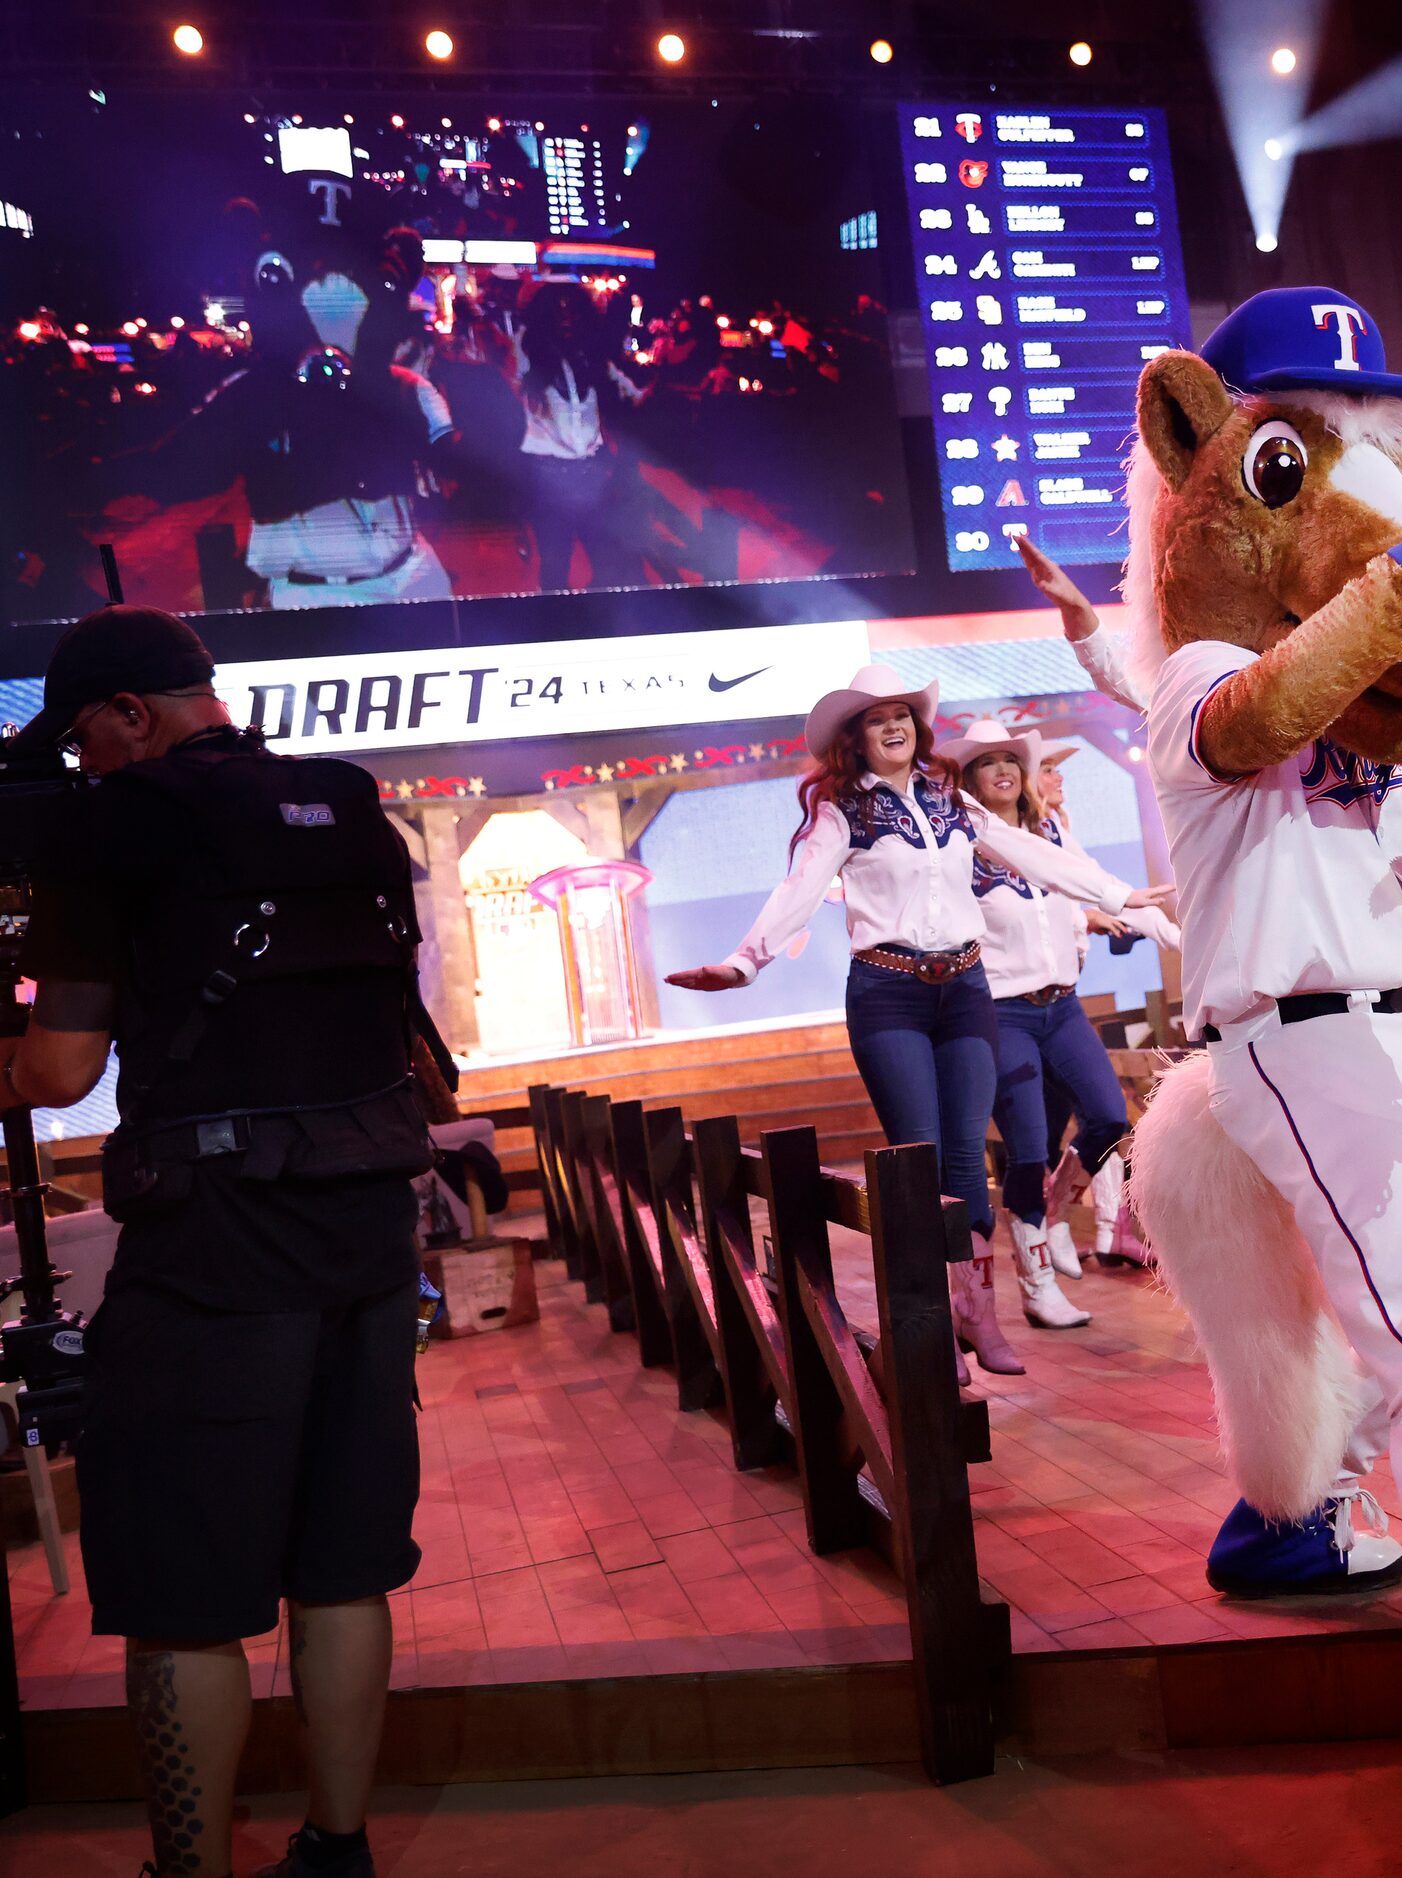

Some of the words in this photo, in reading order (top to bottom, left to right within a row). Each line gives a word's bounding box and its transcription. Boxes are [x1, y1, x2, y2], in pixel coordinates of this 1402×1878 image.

[1311, 305, 1368, 372] T
[248, 667, 499, 740] DRAFT
[972, 1255, 994, 1289] T
[1030, 1241, 1050, 1271] T
